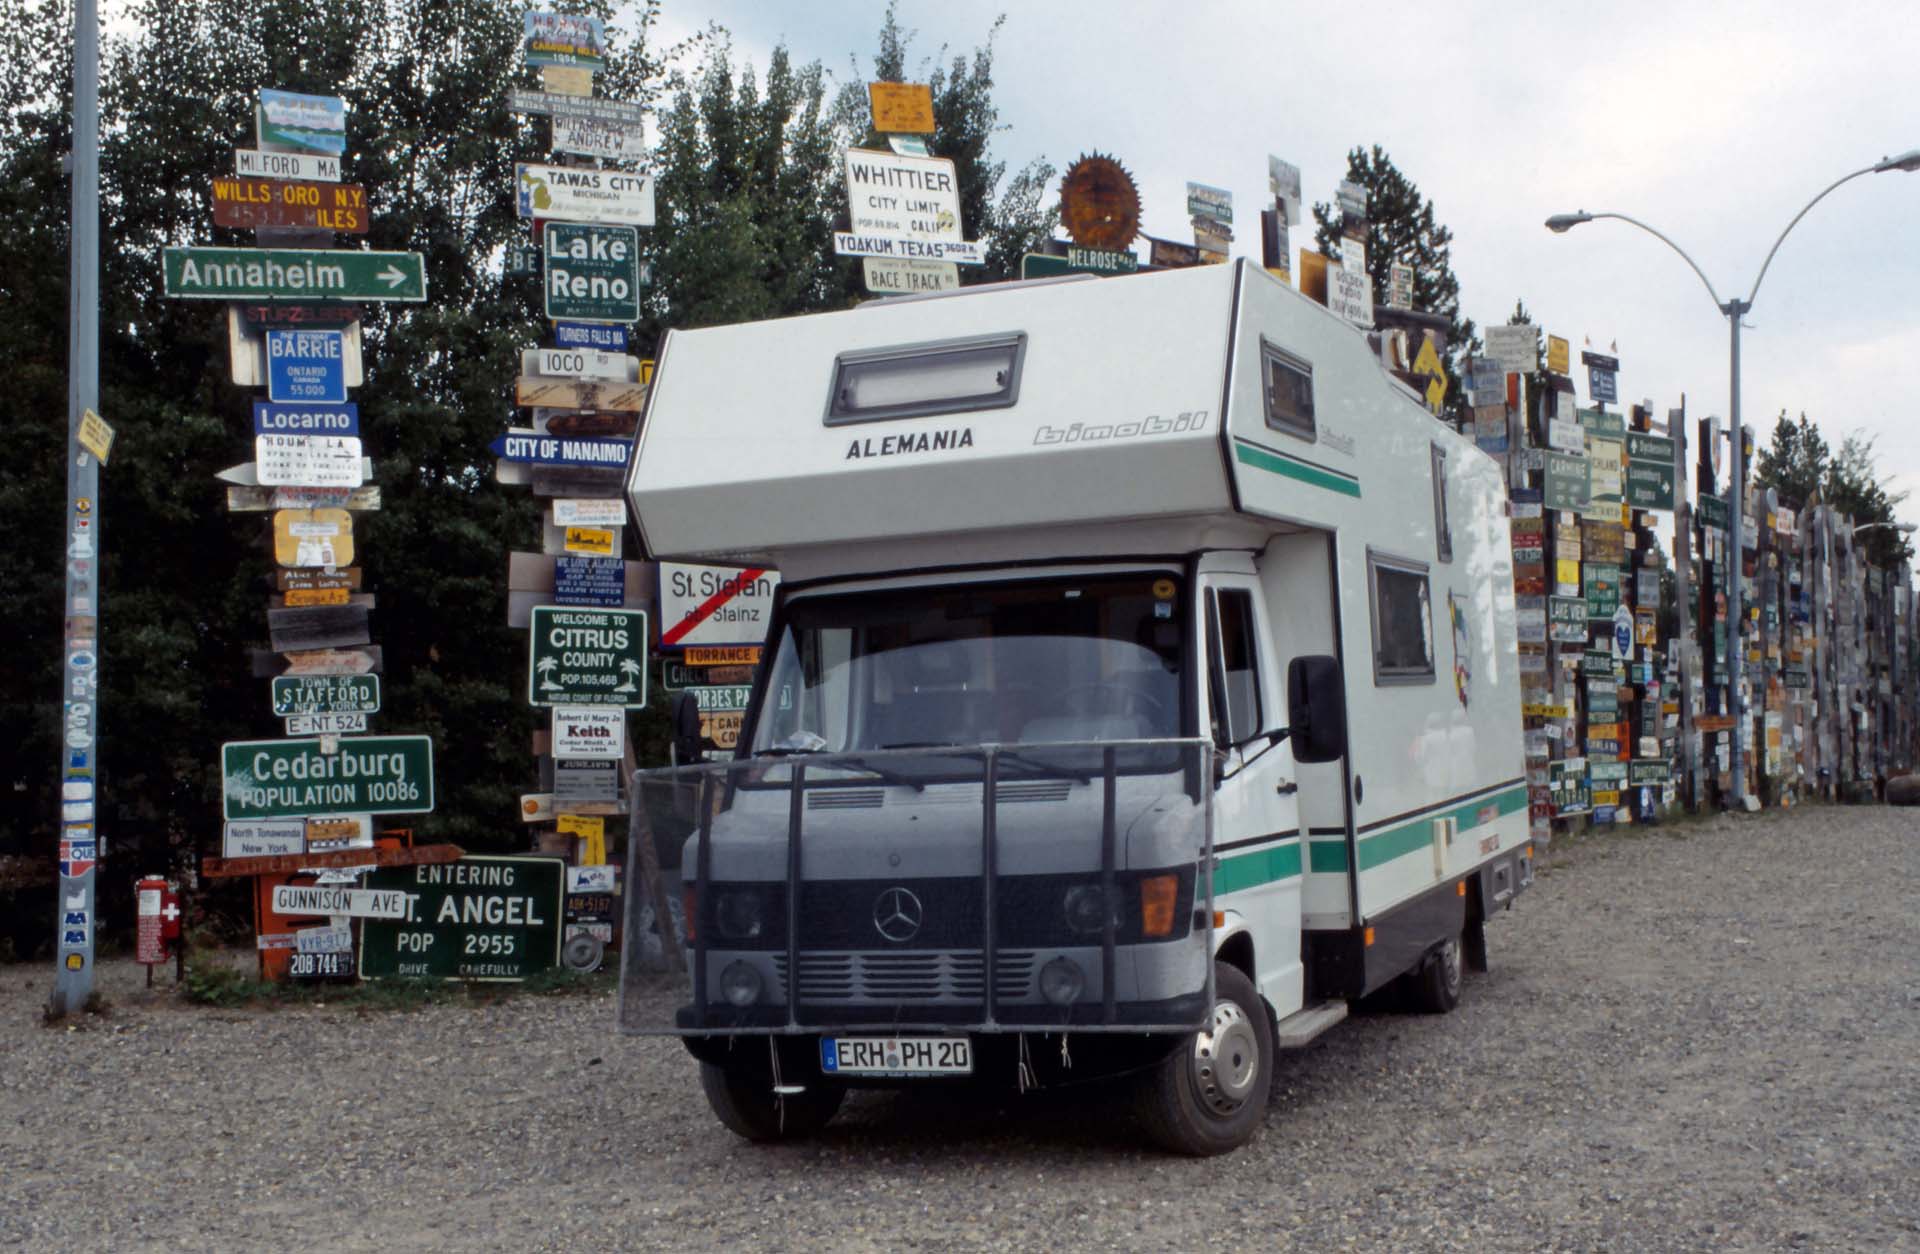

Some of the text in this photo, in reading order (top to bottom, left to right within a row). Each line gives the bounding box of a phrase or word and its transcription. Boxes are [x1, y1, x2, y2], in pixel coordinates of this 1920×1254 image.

[240, 154, 337, 176] MILFORD MA
[548, 171, 645, 192] TAWAS CITY
[852, 164, 952, 192] WHITTIER
[573, 190, 620, 200] MICHIGAN
[869, 196, 940, 213] CITY LIMIT
[550, 230, 627, 261] Lake
[899, 240, 944, 258] TEXAS
[1068, 249, 1119, 270] MELROSE
[180, 258, 345, 288] Annaheim
[872, 270, 899, 288] RACE
[906, 272, 942, 290] TRACK
[551, 269, 628, 299] Reno
[559, 327, 590, 343] TURNERS
[591, 329, 611, 344] FALLS
[271, 339, 341, 358] BARRIE
[287, 366, 327, 377] ONTARIO
[547, 354, 584, 372] IOCO
[262, 409, 350, 428] Locarno
[1033, 411, 1209, 446] bimobil
[506, 438, 626, 463] CITY OF NANAIMO
[845, 428, 974, 460] ALEMANIA
[552, 614, 628, 626] WELCOME TO
[713, 606, 760, 622] Stainz
[550, 628, 629, 649] CITRUS
[562, 652, 615, 668] COUNTY
[689, 649, 750, 662] TORRANCE
[301, 678, 352, 688] TOWN OF
[283, 687, 369, 703] STAFFORD
[329, 700, 358, 711] YORK
[336, 715, 363, 728] 524
[592, 714, 610, 724] Mary
[567, 725, 611, 737] Keith
[254, 750, 406, 784] Cedarburg
[240, 782, 419, 808] POPULATION 10086
[231, 828, 253, 838] North
[257, 828, 300, 838] Tonawanda
[242, 843, 288, 853] New York
[416, 865, 515, 886] ENTERING
[278, 890, 399, 913] GUNNISON AVE
[437, 895, 544, 925] ANGEL
[397, 933, 515, 955] POP 2955
[837, 1042, 968, 1067] ERH PH 20
